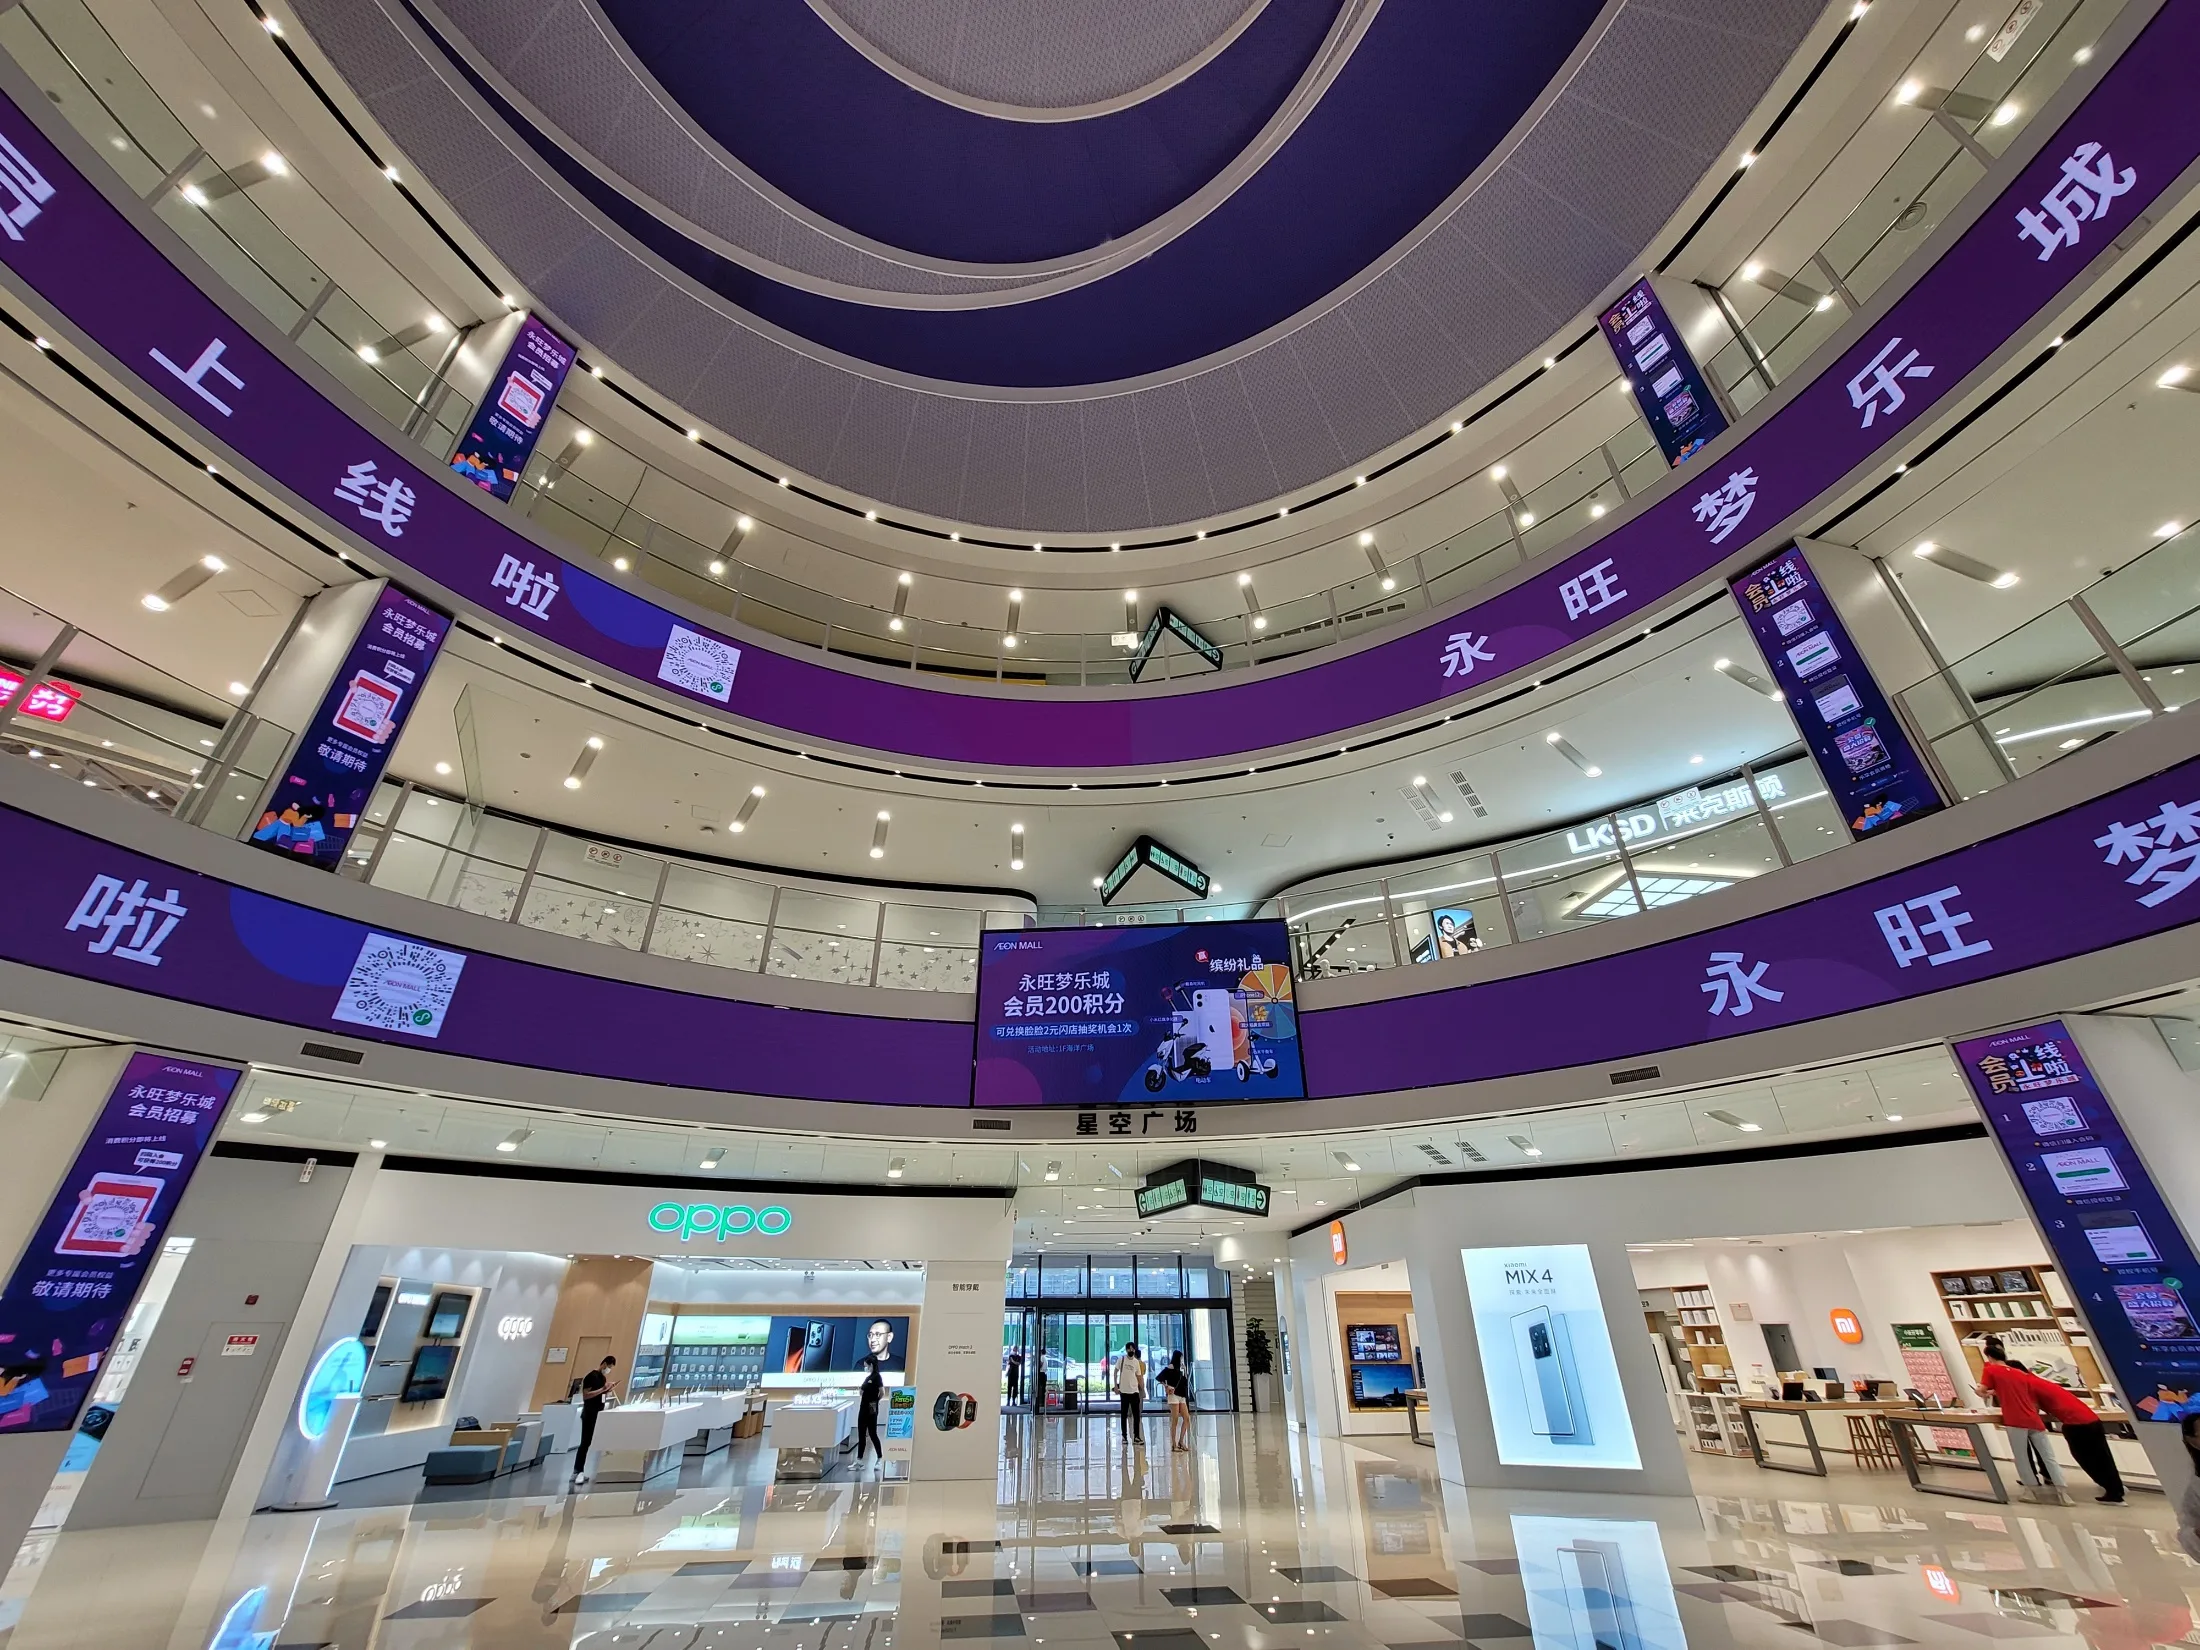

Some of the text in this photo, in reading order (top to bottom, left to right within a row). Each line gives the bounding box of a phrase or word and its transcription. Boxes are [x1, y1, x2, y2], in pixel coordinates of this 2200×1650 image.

[382, 607, 438, 643] 永旺梦乐城
[381, 622, 427, 651] 会员招募
[317, 743, 368, 773] 敬请期待
[1567, 814, 1656, 855] LKSD
[65, 875, 187, 965] 啦
[1018, 940, 1043, 950] MALL
[1701, 953, 1785, 1017] 永
[1874, 886, 1993, 967] 旺
[1209, 953, 1264, 973] 缤纷礼品
[1018, 971, 1111, 993] 永旺梦乐城
[1003, 992, 1126, 1018] 会员200积分
[996, 1022, 1133, 1038] 可兑换脸脸2元闪店抽奖机会1次
[2009, 1034, 2031, 1043] MALL
[183, 1069, 203, 1078] MALL
[128, 1084, 216, 1110] 永旺梦乐城
[128, 1103, 199, 1125] 会员招募
[1076, 1111, 1198, 1136] 星空广场
[2026, 1163, 2036, 1171] 2
[2055, 1220, 2066, 1229] 3
[952, 1283, 980, 1292] 智能穿戴
[1505, 1269, 1554, 1285] MIX 4
[31, 1280, 114, 1300] 敬请期待
[2092, 1292, 2102, 1301] 4
